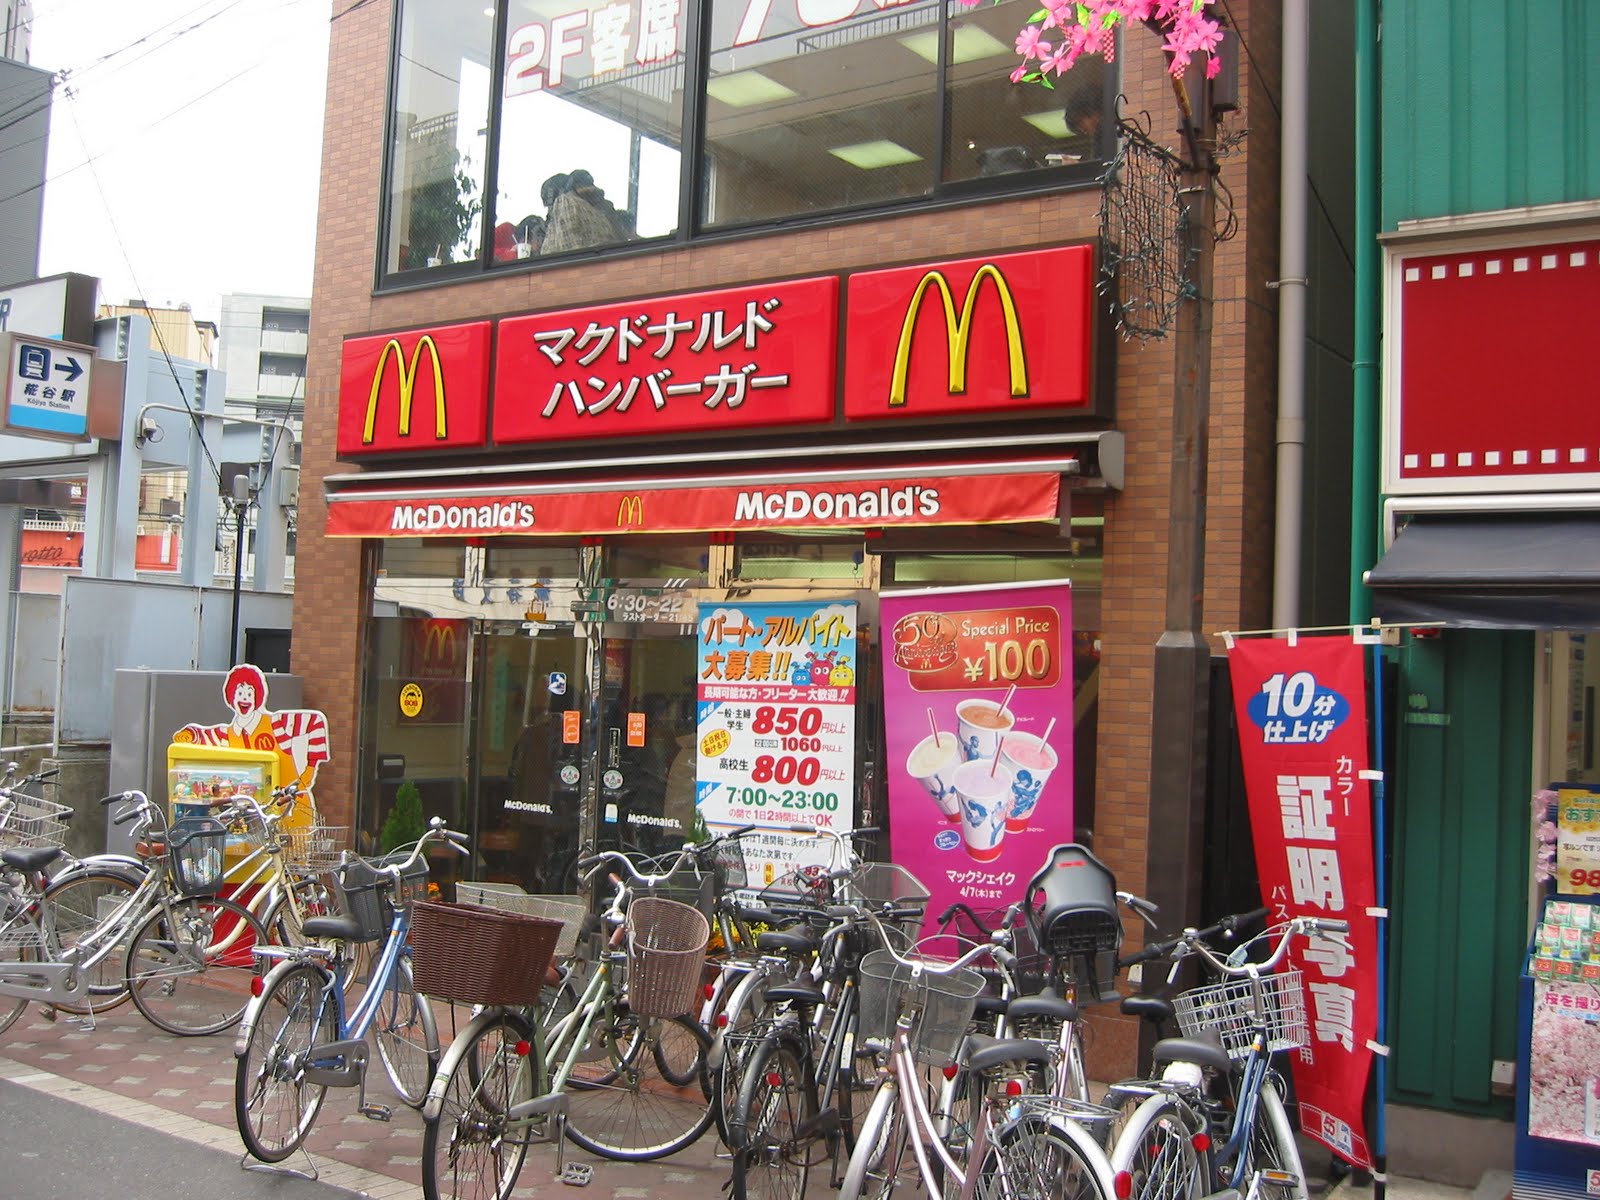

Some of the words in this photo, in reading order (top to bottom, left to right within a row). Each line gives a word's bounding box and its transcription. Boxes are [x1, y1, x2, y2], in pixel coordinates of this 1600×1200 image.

[533, 297, 781, 367] マクドナルド
[541, 363, 790, 418] ハンバーガー
[391, 501, 535, 530] McDonald's
[734, 486, 941, 521] McDonald's
[703, 613, 852, 648] パート・アルバイト
[961, 616, 1010, 640] Special
[1014, 616, 1051, 635] Price
[702, 650, 792, 682] 大募集!!
[961, 637, 1052, 683] ¥100
[1261, 671, 1337, 717] 10分
[726, 720, 744, 731] 学生
[752, 706, 823, 737] 850
[1263, 720, 1336, 743] 仕上げ
[781, 736, 822, 753] 1060
[719, 758, 749, 771] 高校生
[751, 755, 821, 786] 800
[1336, 755, 1353, 817] カラー
[945, 870, 1016, 886] マックシェイク
